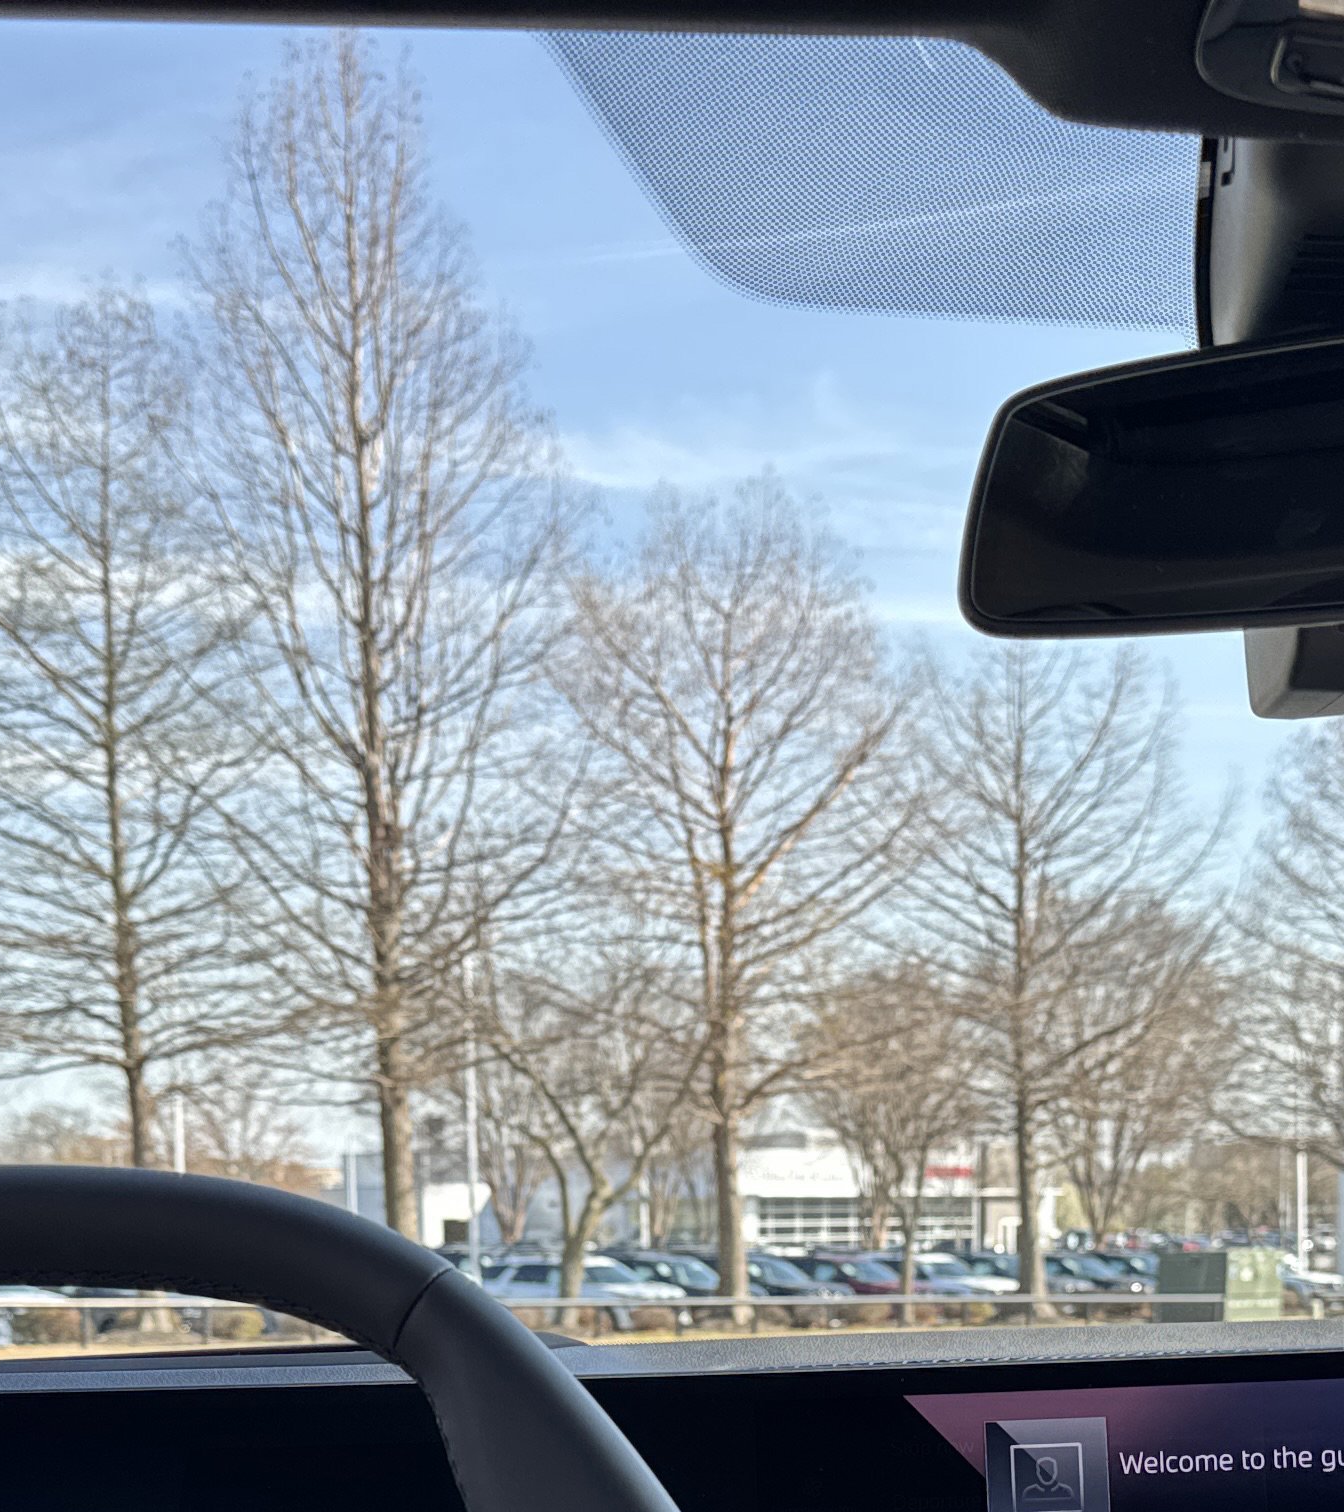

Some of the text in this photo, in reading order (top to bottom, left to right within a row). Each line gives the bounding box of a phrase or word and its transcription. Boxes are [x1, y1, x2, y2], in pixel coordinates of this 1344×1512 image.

[1119, 1450, 1234, 1475] Welcome
[1242, 1450, 1265, 1470] to
[1273, 1446, 1313, 1469] the
